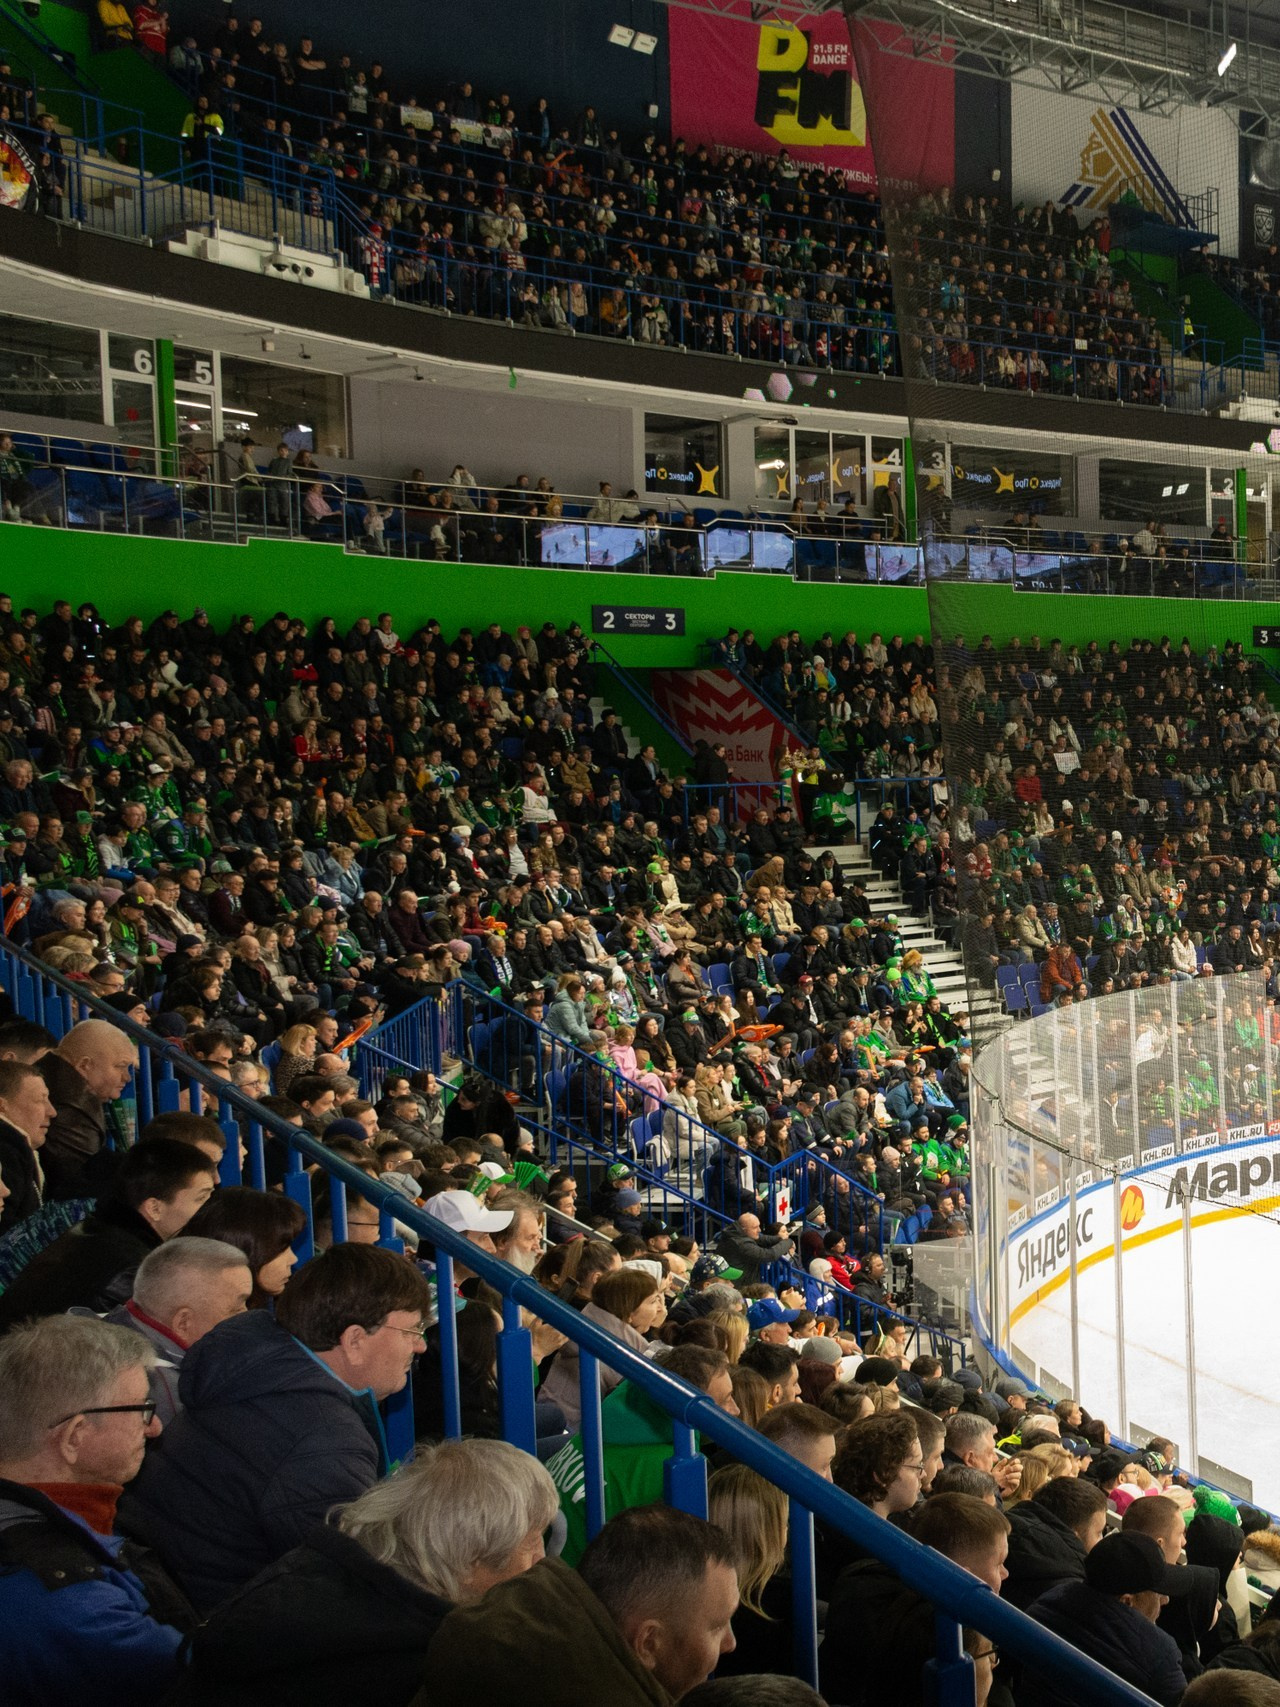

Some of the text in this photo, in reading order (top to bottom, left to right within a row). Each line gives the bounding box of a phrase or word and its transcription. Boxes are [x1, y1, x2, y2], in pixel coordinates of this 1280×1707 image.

[813, 44, 848, 54] 91.5 FM
[813, 54, 848, 65] DANCE
[134, 349, 152, 374] 6
[195, 360, 213, 385] 5
[887, 448, 901, 466] 4
[931, 451, 945, 470] 3
[1223, 477, 1234, 494] 2
[602, 611, 615, 629] 2
[664, 613, 676, 631] 3
[1260, 630, 1269, 644] 3
[1229, 1122, 1263, 1141] KHL.RU
[1186, 1135, 1217, 1151] KHL.RU
[1143, 1146, 1173, 1163] KHL.RU
[1037, 1189, 1059, 1210] KHL.RU
[1017, 1207, 1094, 1290] Яндекс
